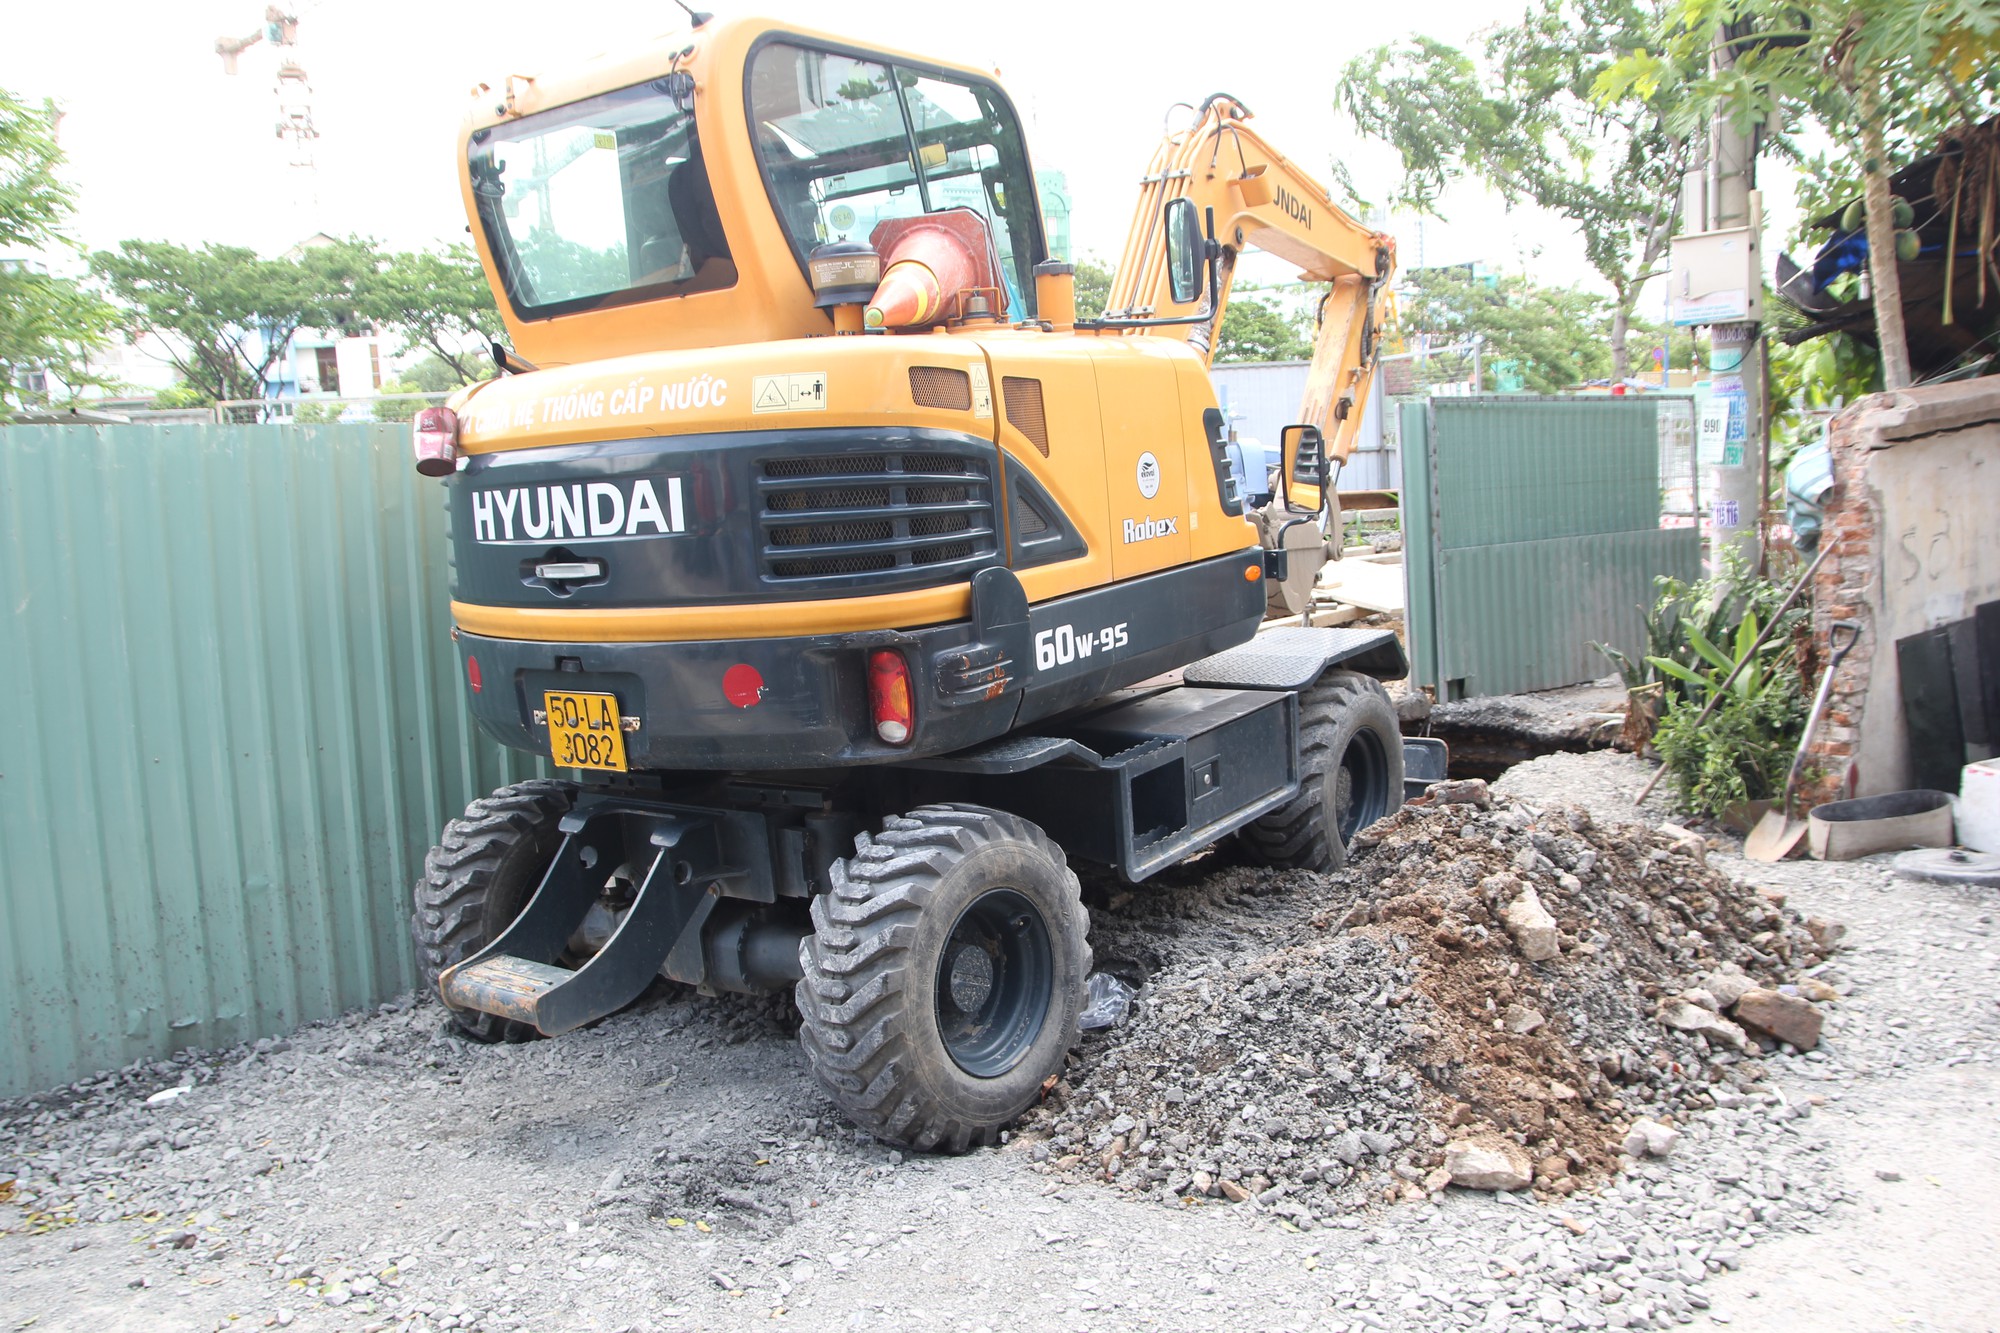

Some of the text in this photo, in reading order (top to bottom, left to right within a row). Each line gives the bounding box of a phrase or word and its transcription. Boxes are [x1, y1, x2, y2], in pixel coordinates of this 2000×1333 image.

[542, 384, 605, 424] THỐNG
[609, 377, 654, 416] CẤP
[660, 373, 728, 412] NƯỚC
[472, 477, 685, 541] HYUNDAI
[1123, 515, 1178, 544] Robex
[560, 731, 617, 767] 3082
